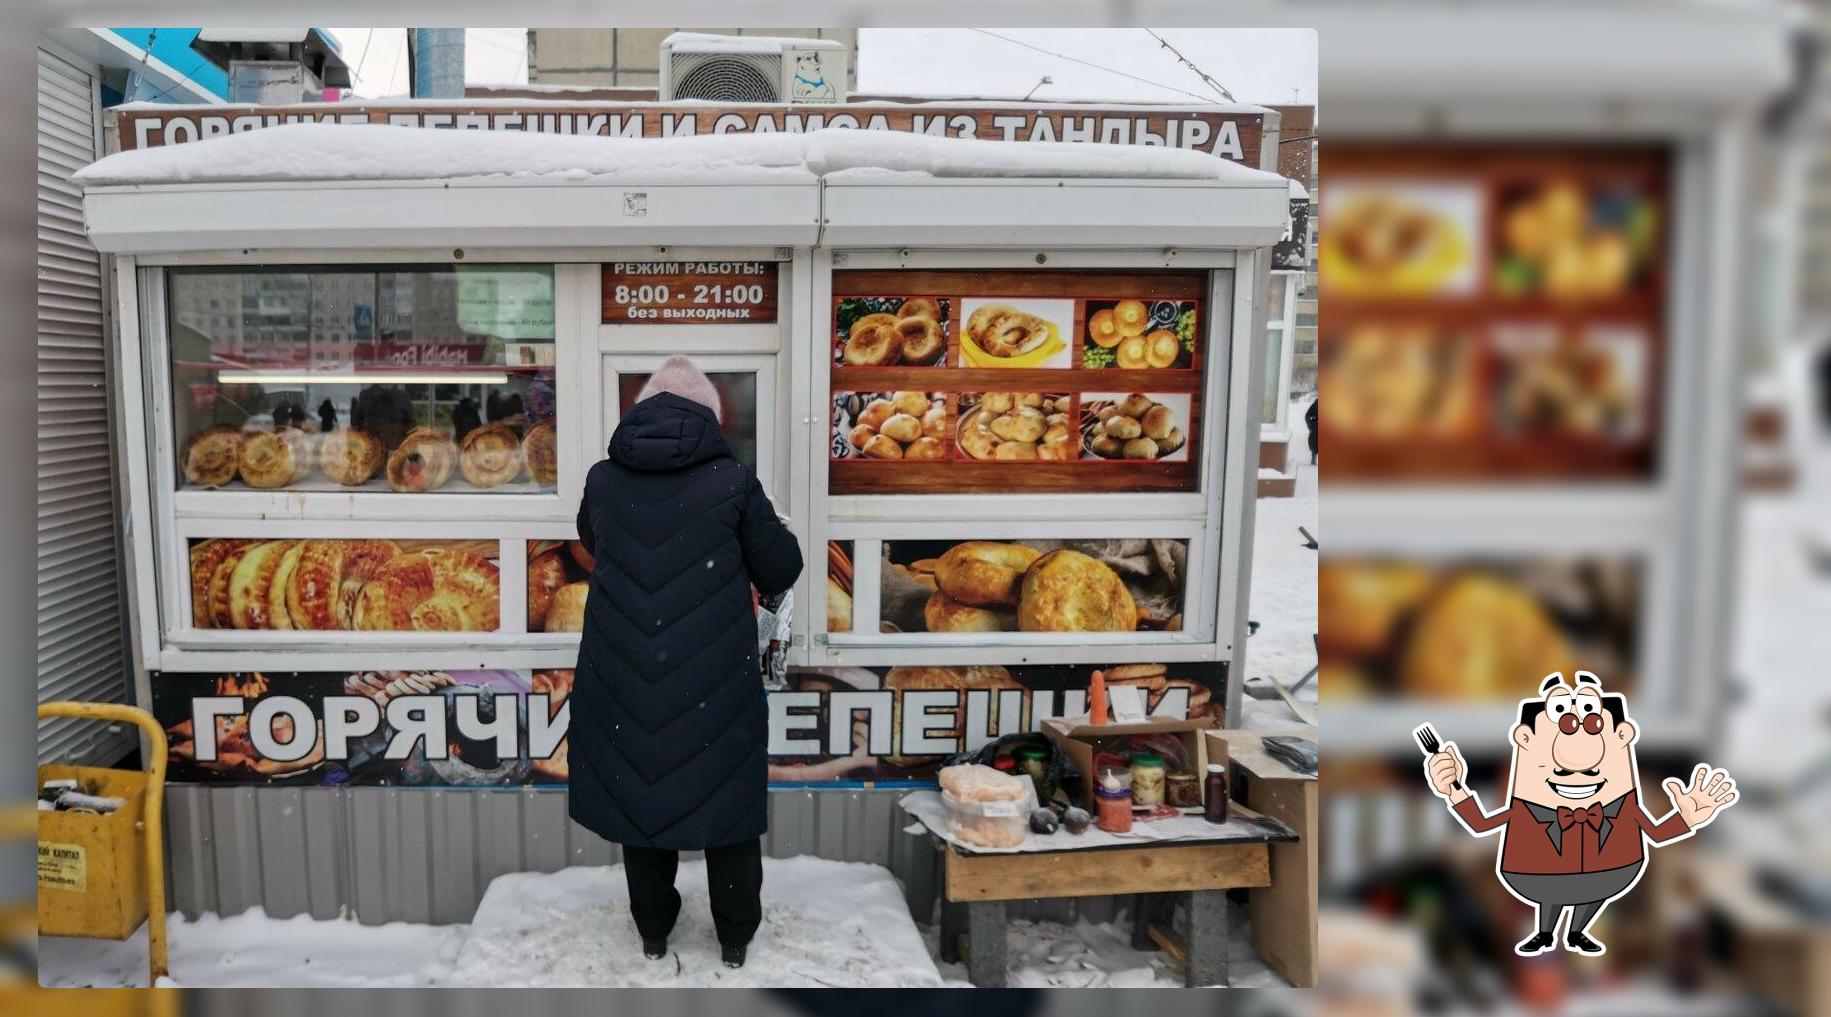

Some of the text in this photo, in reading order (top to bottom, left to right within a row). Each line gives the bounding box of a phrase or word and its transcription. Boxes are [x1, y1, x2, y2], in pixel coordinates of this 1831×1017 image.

[662, 113, 698, 138] И
[912, 114, 978, 140] ИЗ
[614, 263, 764, 275] РЕЖИМ РАБОТЫ:
[615, 285, 669, 304] 8:00
[693, 285, 764, 304] 21:00
[627, 306, 750, 319] без выходных
[191, 690, 1190, 762] ГОРЯЧИ ЕПЕШ
